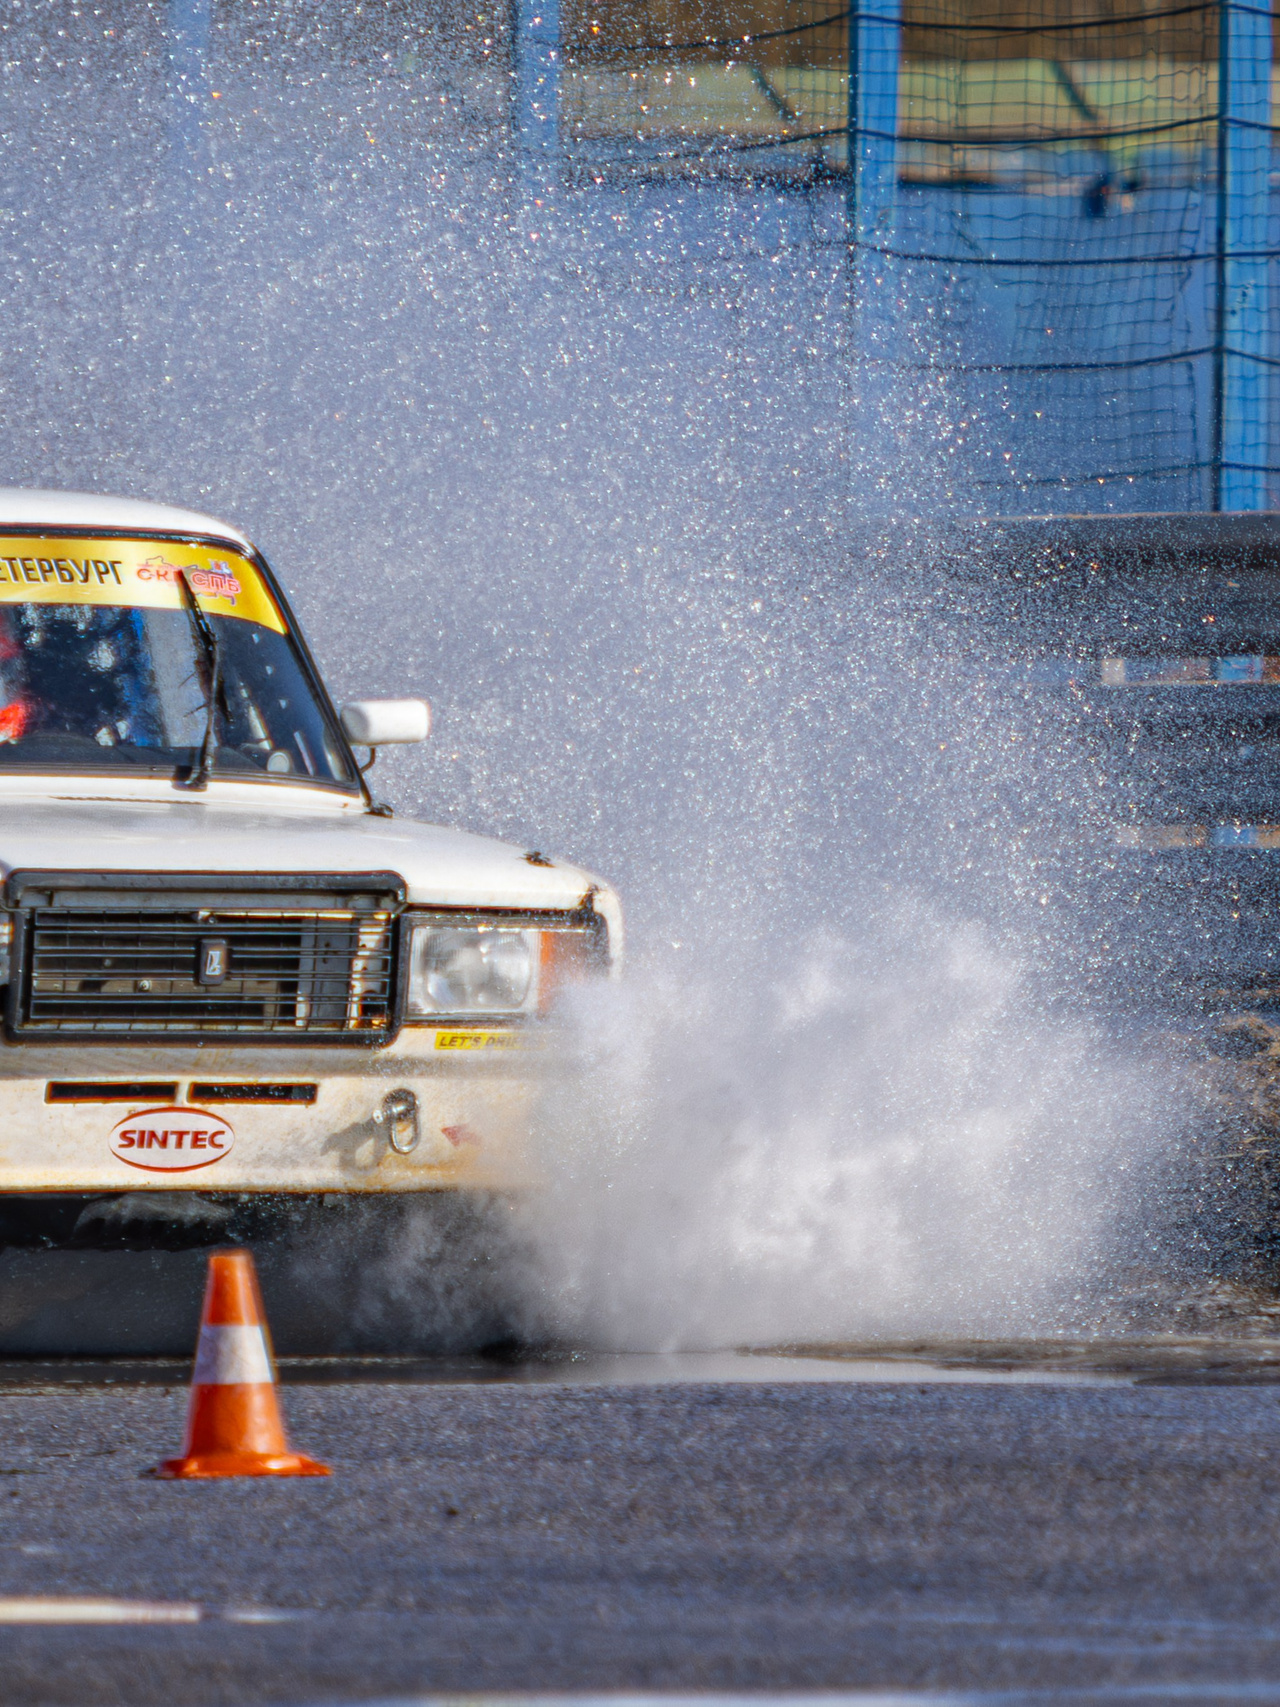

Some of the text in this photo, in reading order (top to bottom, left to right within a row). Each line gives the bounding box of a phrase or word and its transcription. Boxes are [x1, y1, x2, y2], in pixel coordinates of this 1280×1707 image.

[191, 571, 242, 594] СПБ
[439, 1035, 482, 1047] LET'S
[118, 1129, 226, 1150] SINTEC
